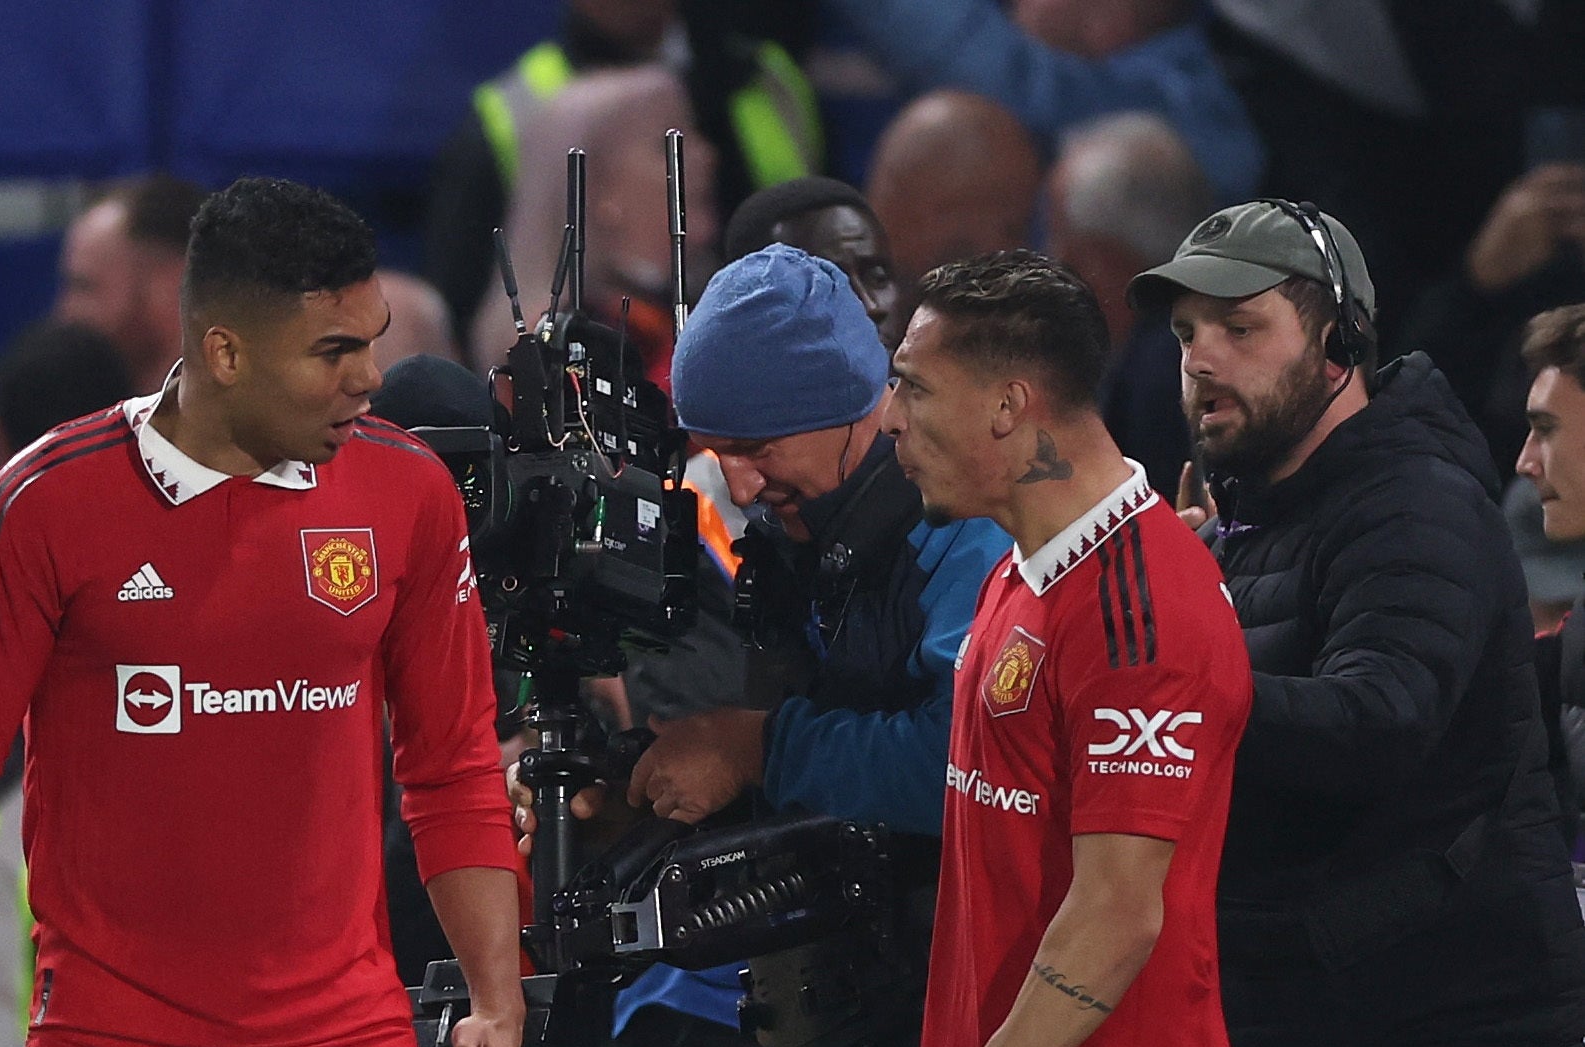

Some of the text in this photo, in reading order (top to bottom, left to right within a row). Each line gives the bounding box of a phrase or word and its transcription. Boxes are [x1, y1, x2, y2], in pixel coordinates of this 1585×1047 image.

[317, 543, 364, 562] MANCHESTER
[117, 586, 174, 601] adidas
[328, 585, 361, 596] UNITED
[185, 680, 361, 714] TeamViewer
[1088, 708, 1203, 761] DXC
[1088, 761, 1193, 779] TECHNOLOGY
[700, 850, 747, 869] STEADICAM
